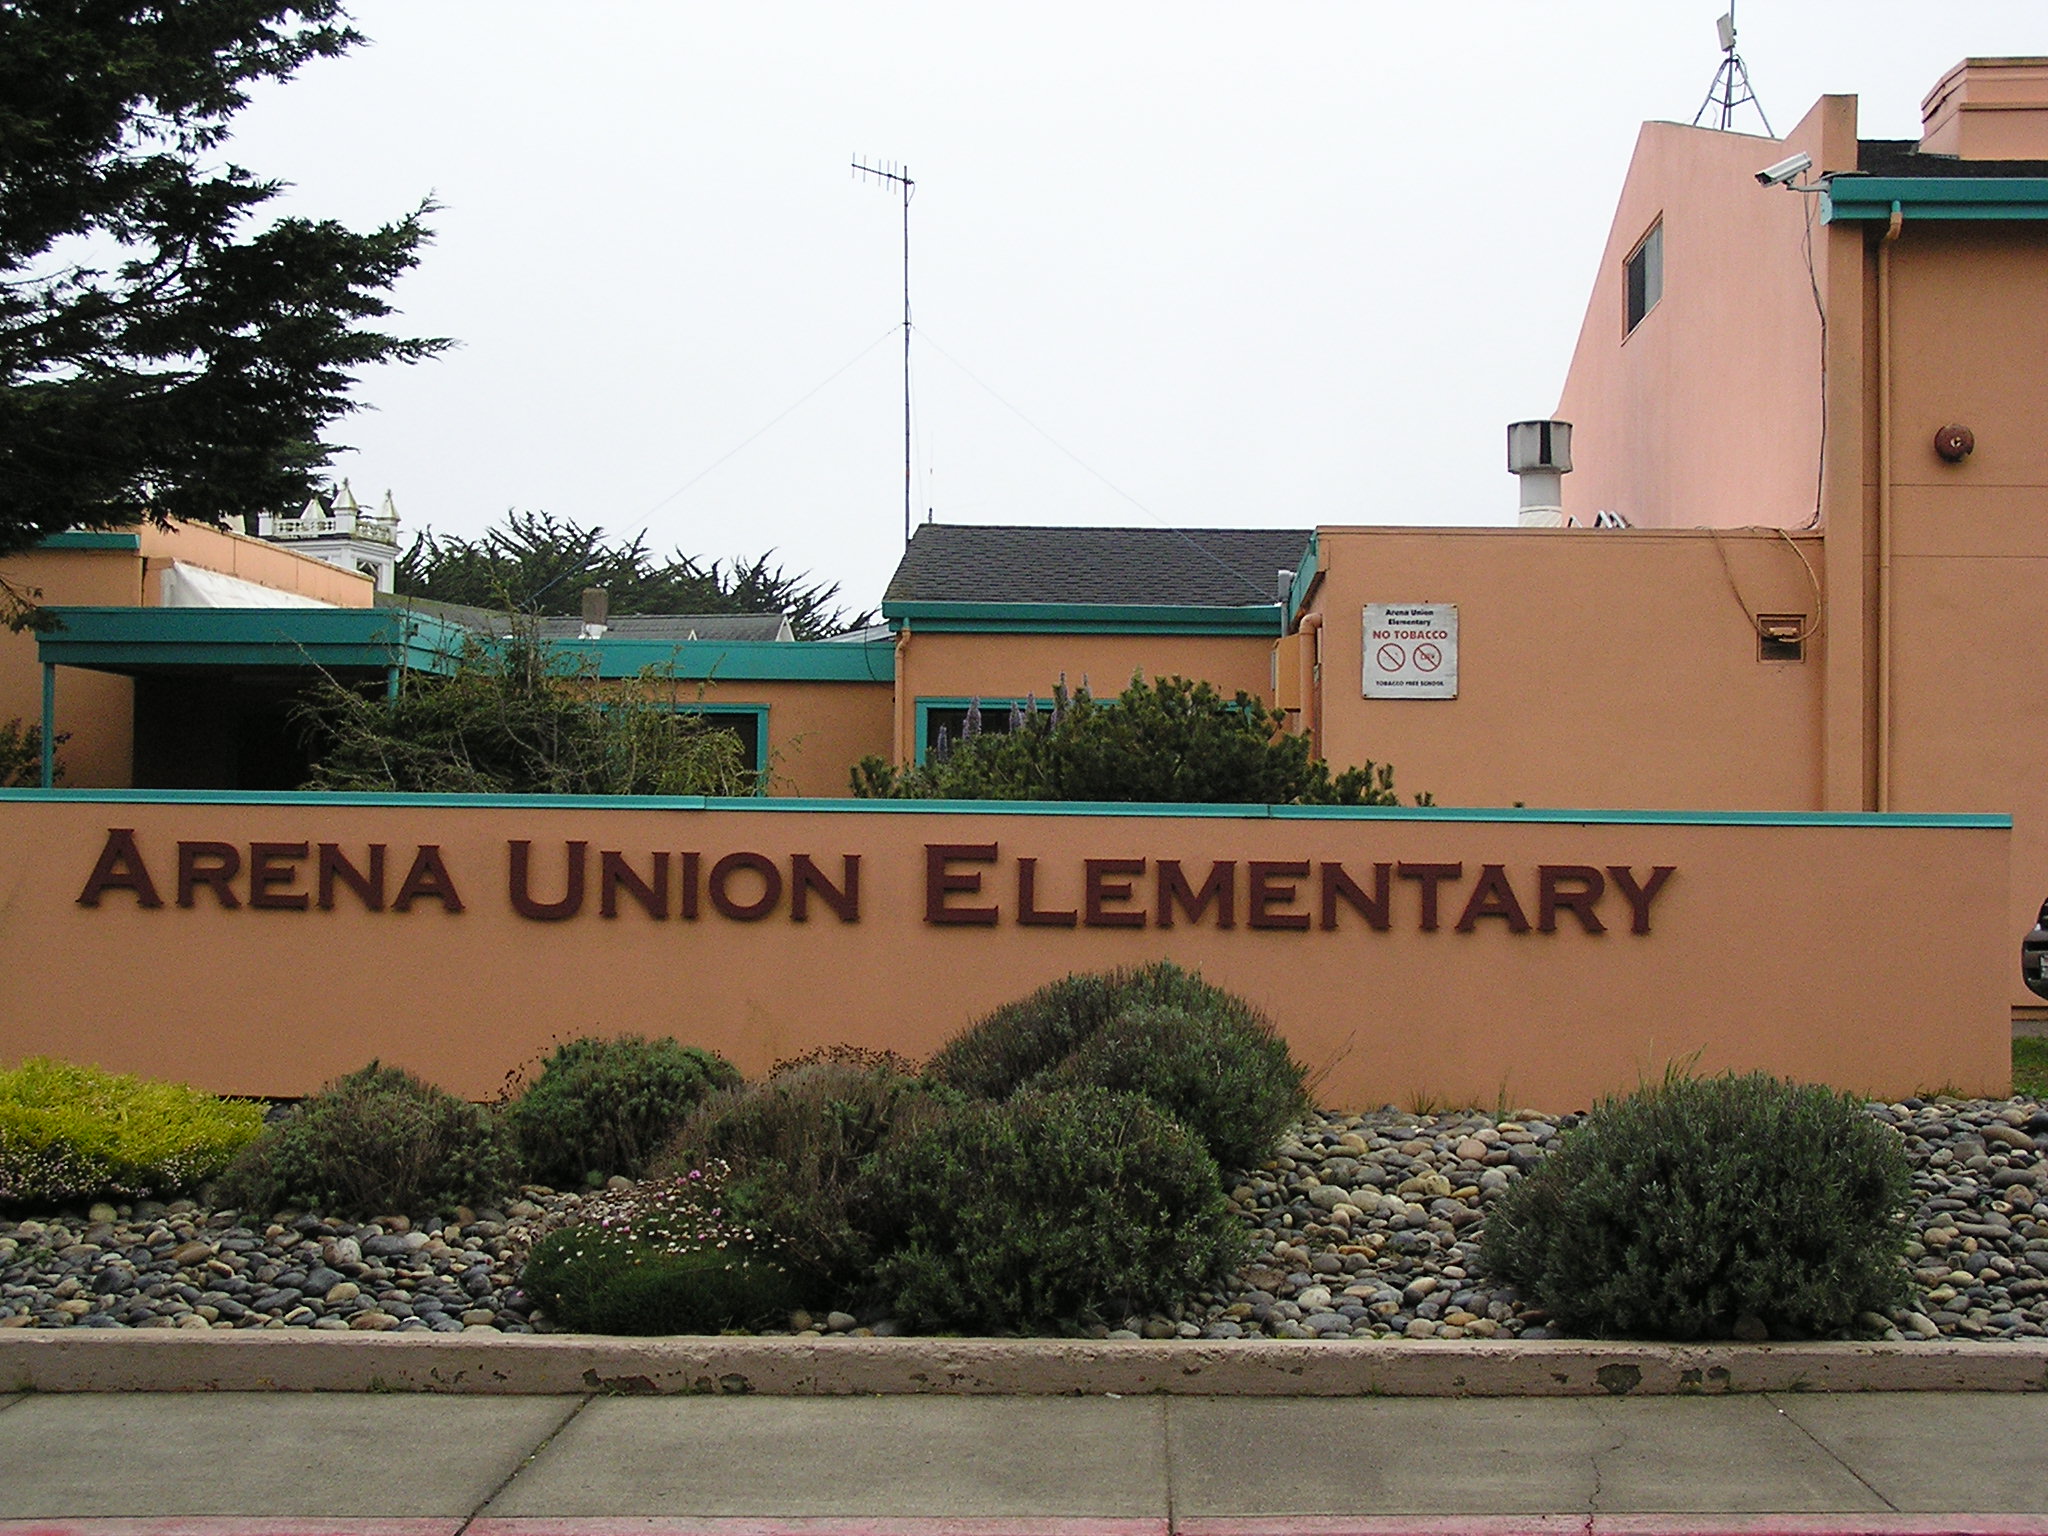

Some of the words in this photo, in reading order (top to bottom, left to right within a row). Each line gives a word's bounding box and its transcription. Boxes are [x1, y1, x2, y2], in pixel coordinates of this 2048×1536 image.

[1373, 630, 1391, 639] NO
[1394, 630, 1448, 639] TOBACCO
[75, 828, 466, 914] ARENA
[507, 840, 862, 923] UNION
[923, 842, 1677, 936] ELEMENTARY
